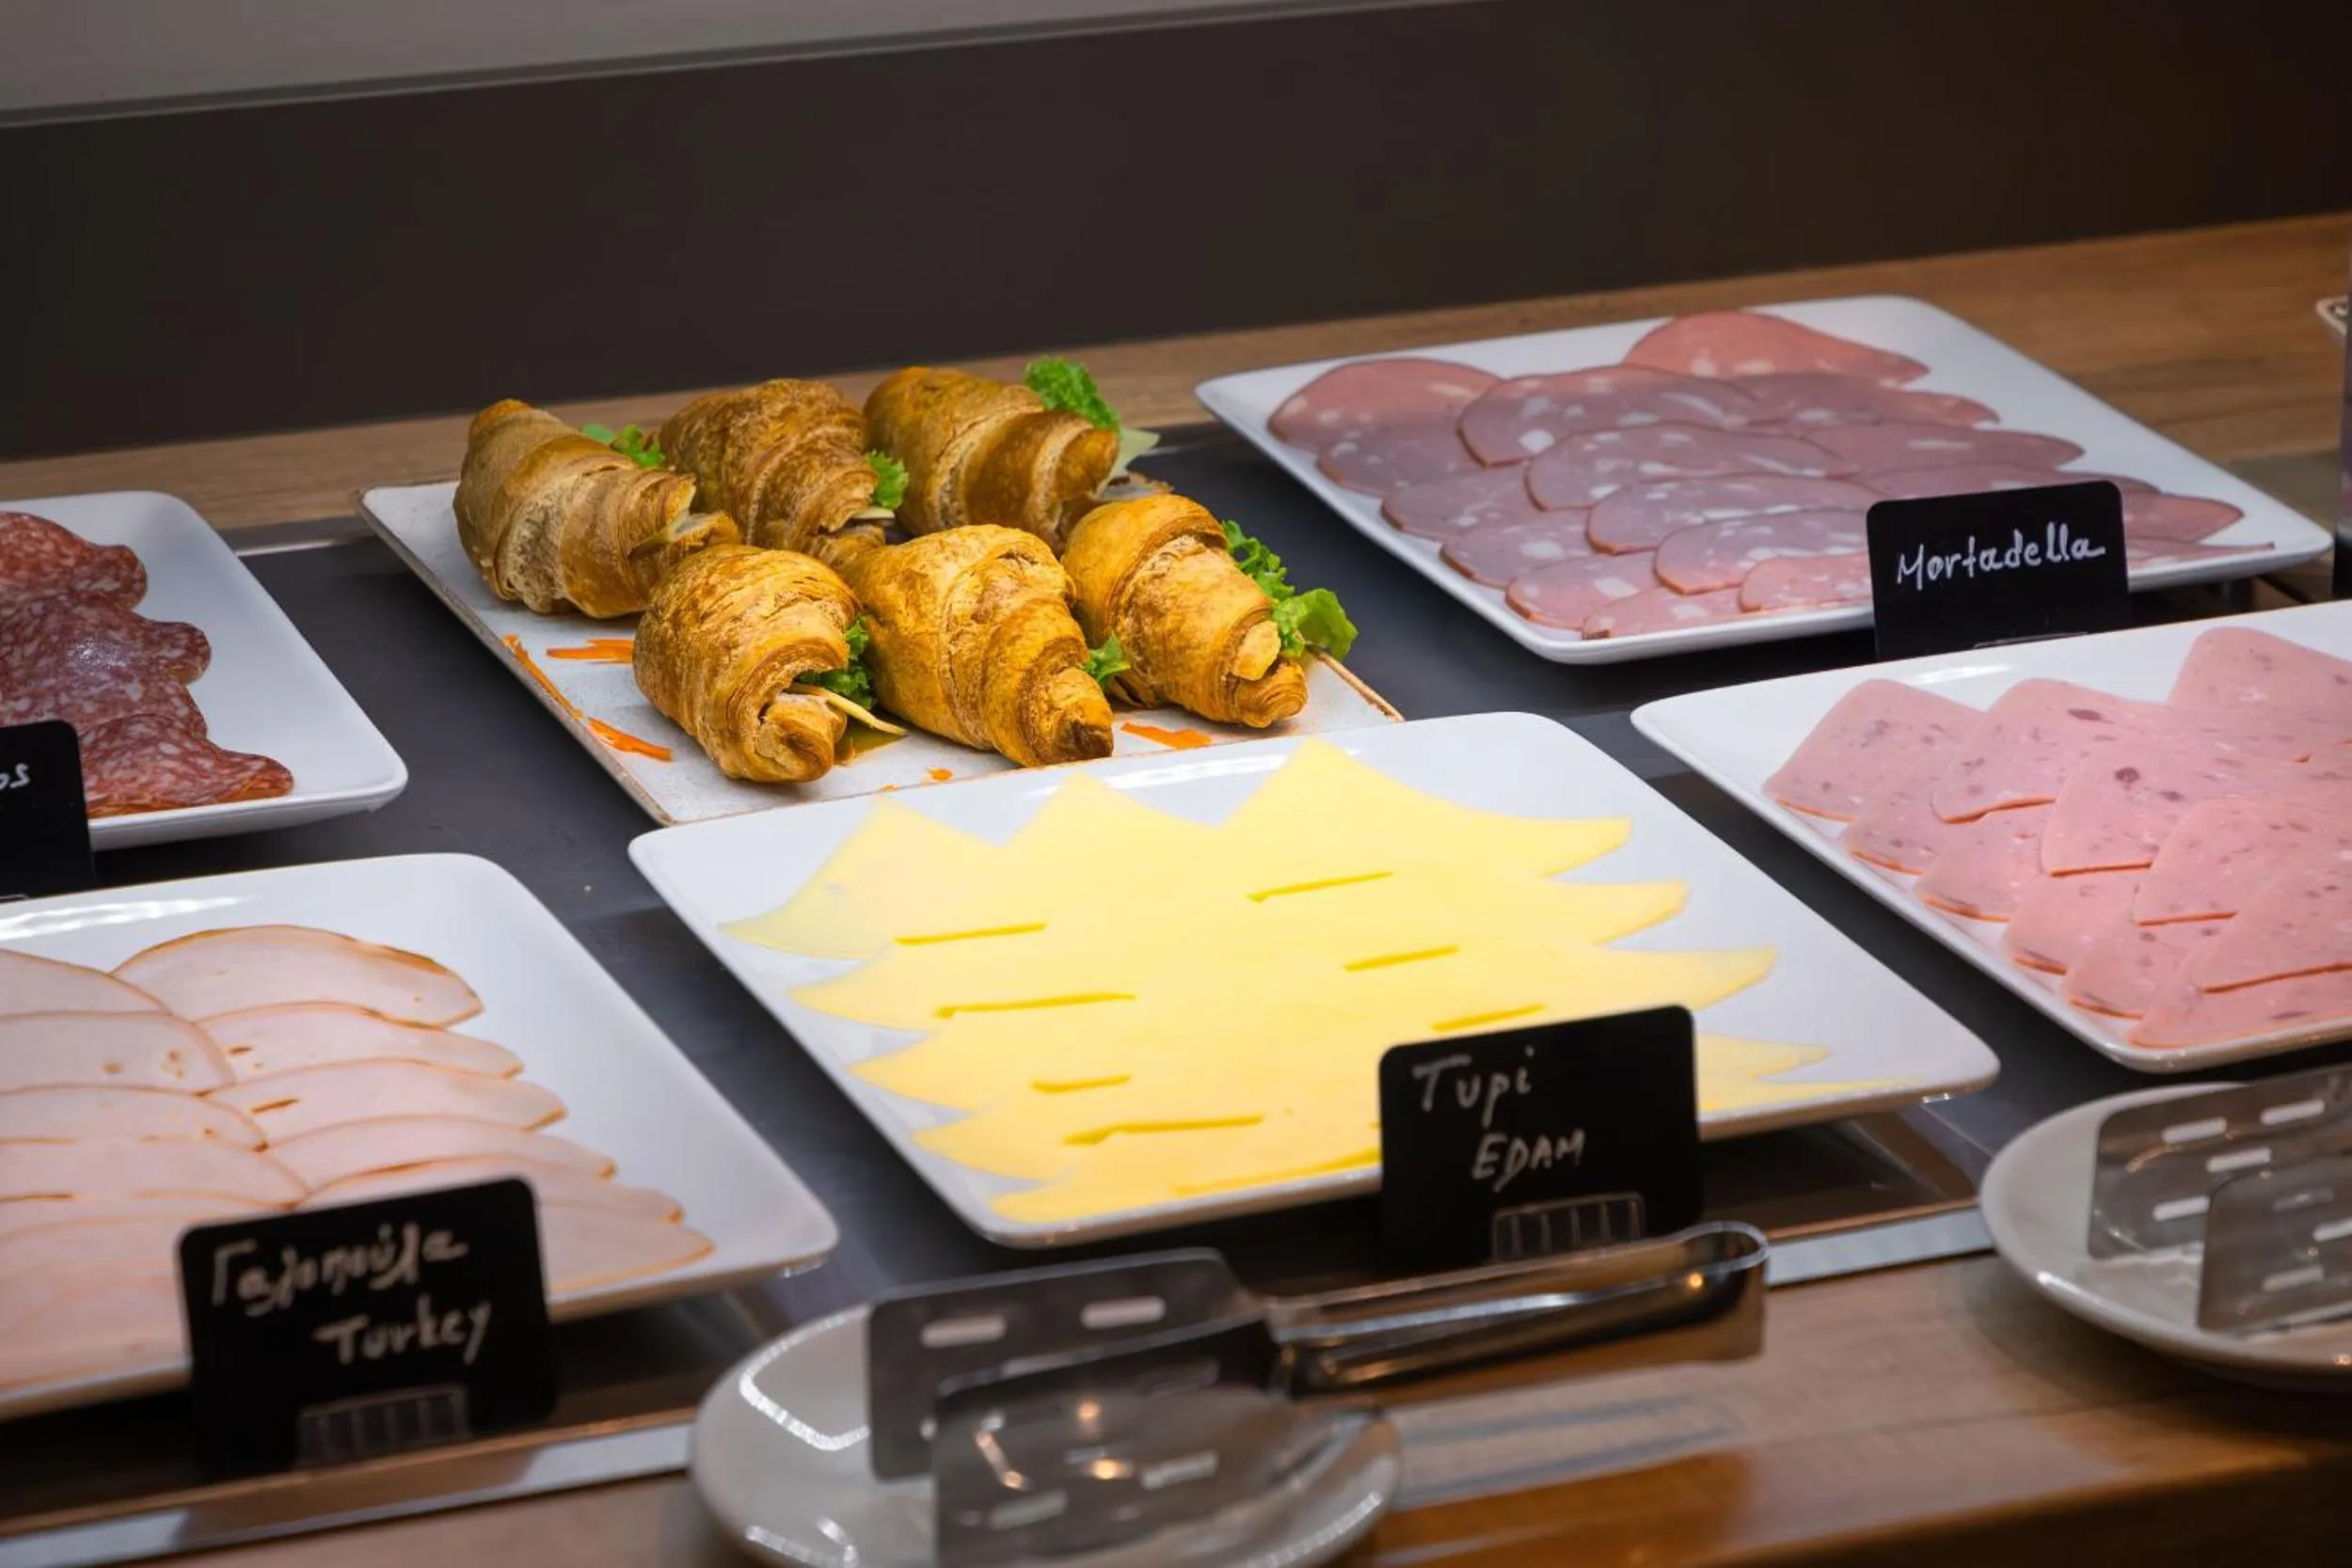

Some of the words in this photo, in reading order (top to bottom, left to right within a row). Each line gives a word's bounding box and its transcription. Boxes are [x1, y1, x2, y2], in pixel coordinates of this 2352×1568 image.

[1897, 521, 2106, 591] Mortadella
[1471, 1128, 1585, 1193] EDAM
[313, 1294, 492, 1365] Turkey
